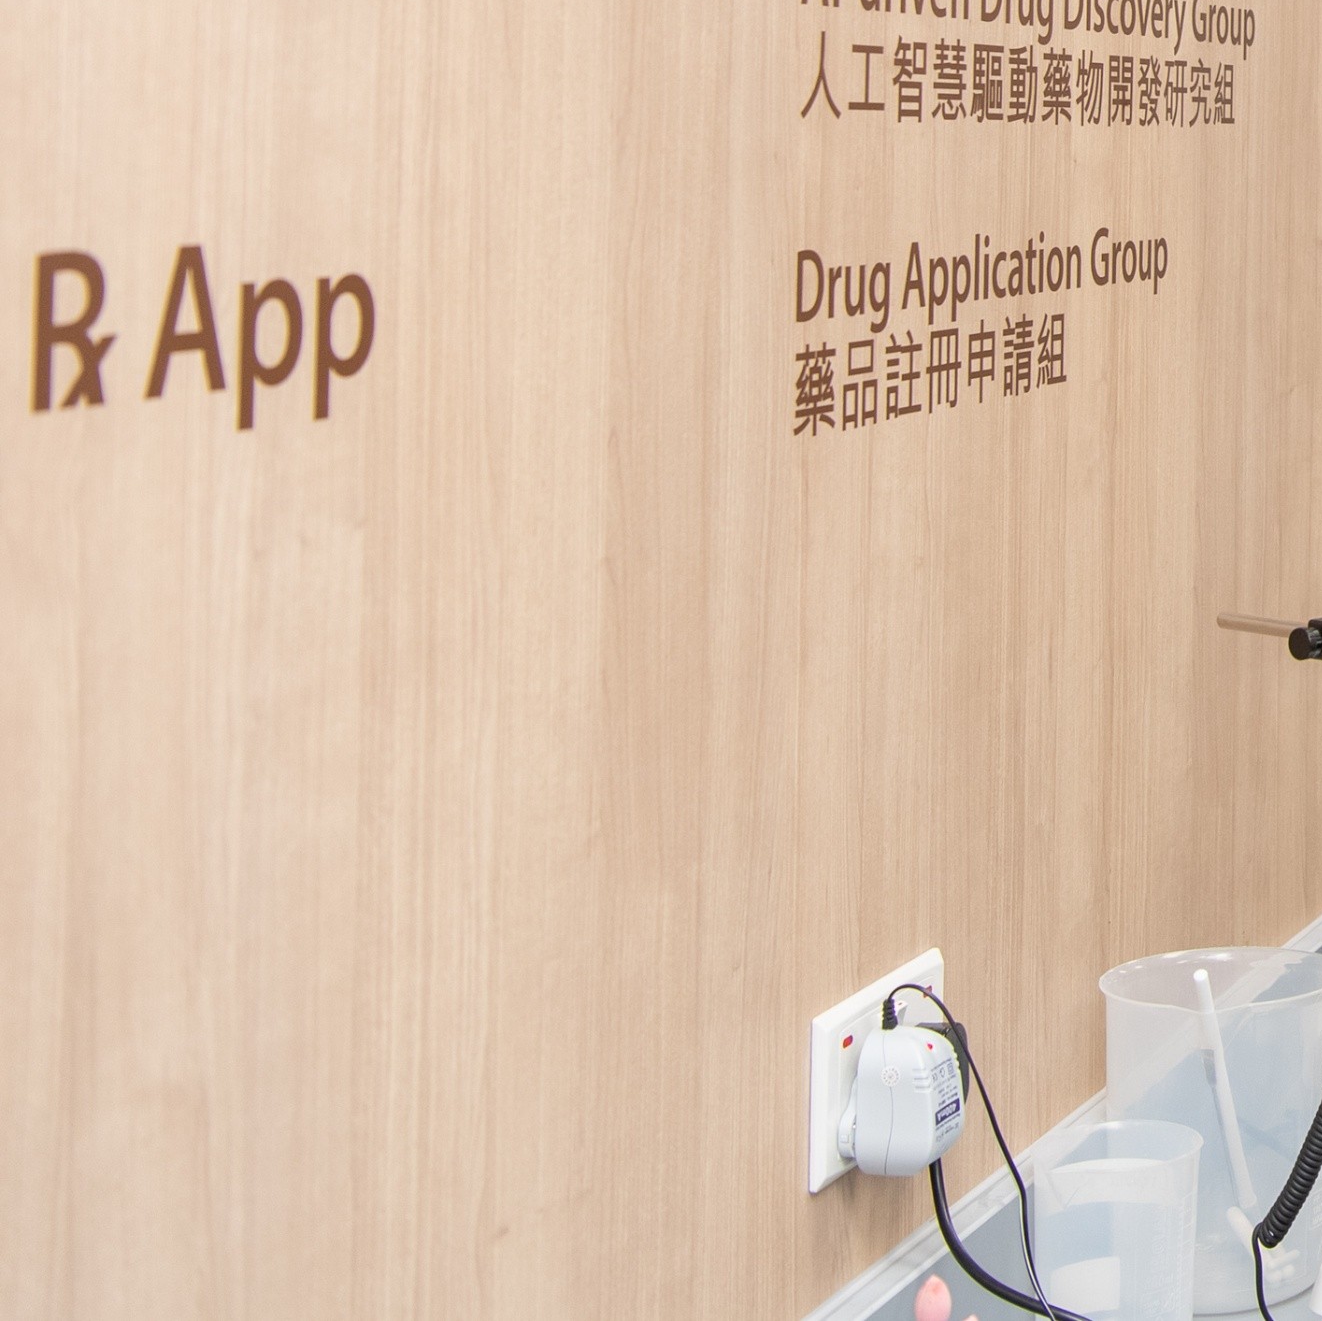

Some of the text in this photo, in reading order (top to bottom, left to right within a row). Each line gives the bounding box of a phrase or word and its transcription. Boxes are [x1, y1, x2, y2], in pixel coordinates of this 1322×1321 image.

[799, 30, 1236, 129] 人工智慧驅動藥物開發研究組
[143, 243, 377, 431] App
[795, 226, 1169, 334] Drug Application Group
[792, 312, 1068, 437] 藥品註冊申請組
